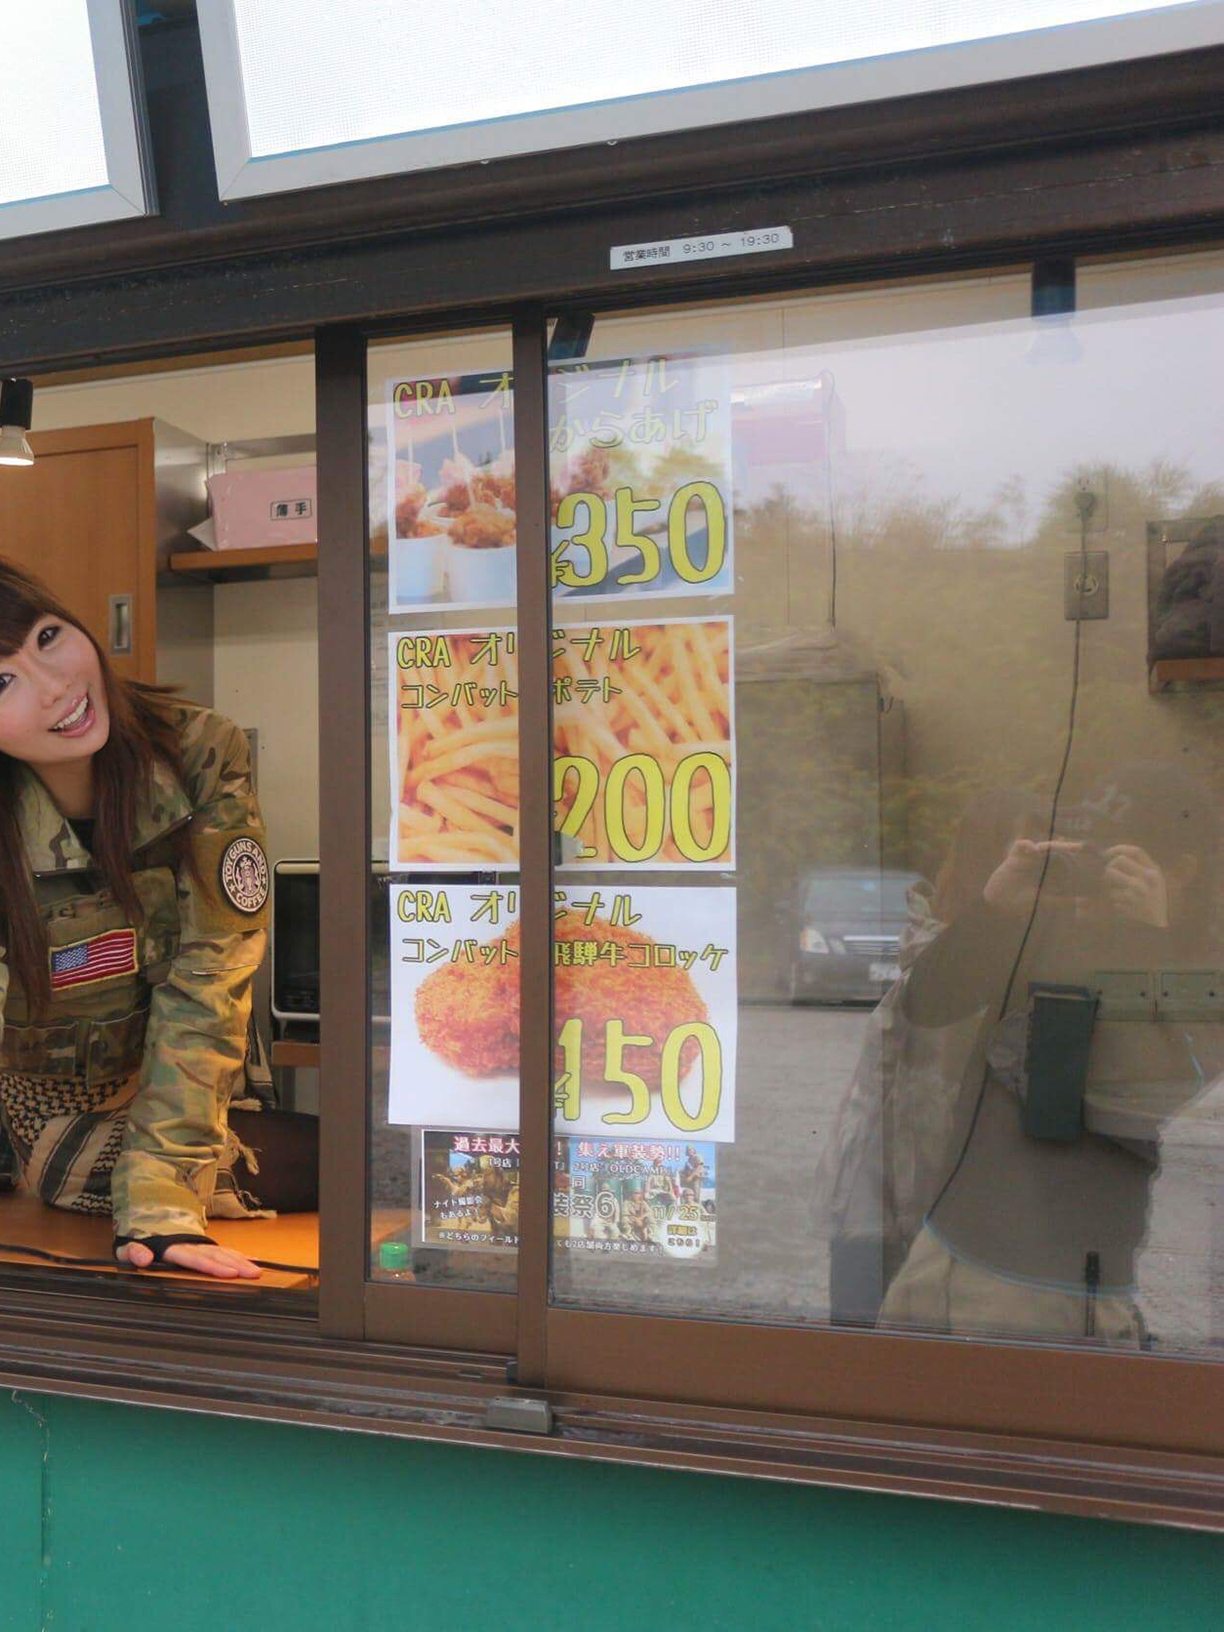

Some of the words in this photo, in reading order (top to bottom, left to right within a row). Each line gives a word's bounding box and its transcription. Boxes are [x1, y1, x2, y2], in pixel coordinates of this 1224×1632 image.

[623, 246, 671, 262] 営業時間
[683, 241, 715, 254] 9:30
[741, 233, 780, 247] 19:30
[393, 379, 455, 419] CRA
[397, 636, 451, 669] CRA
[401, 680, 519, 710] コンバット
[229, 841, 252, 859] GUNS
[252, 847, 266, 875] AND
[225, 857, 233, 883] TOY
[236, 887, 265, 907] COFFEE
[397, 890, 451, 923] CRA
[401, 937, 519, 967] コンバット
